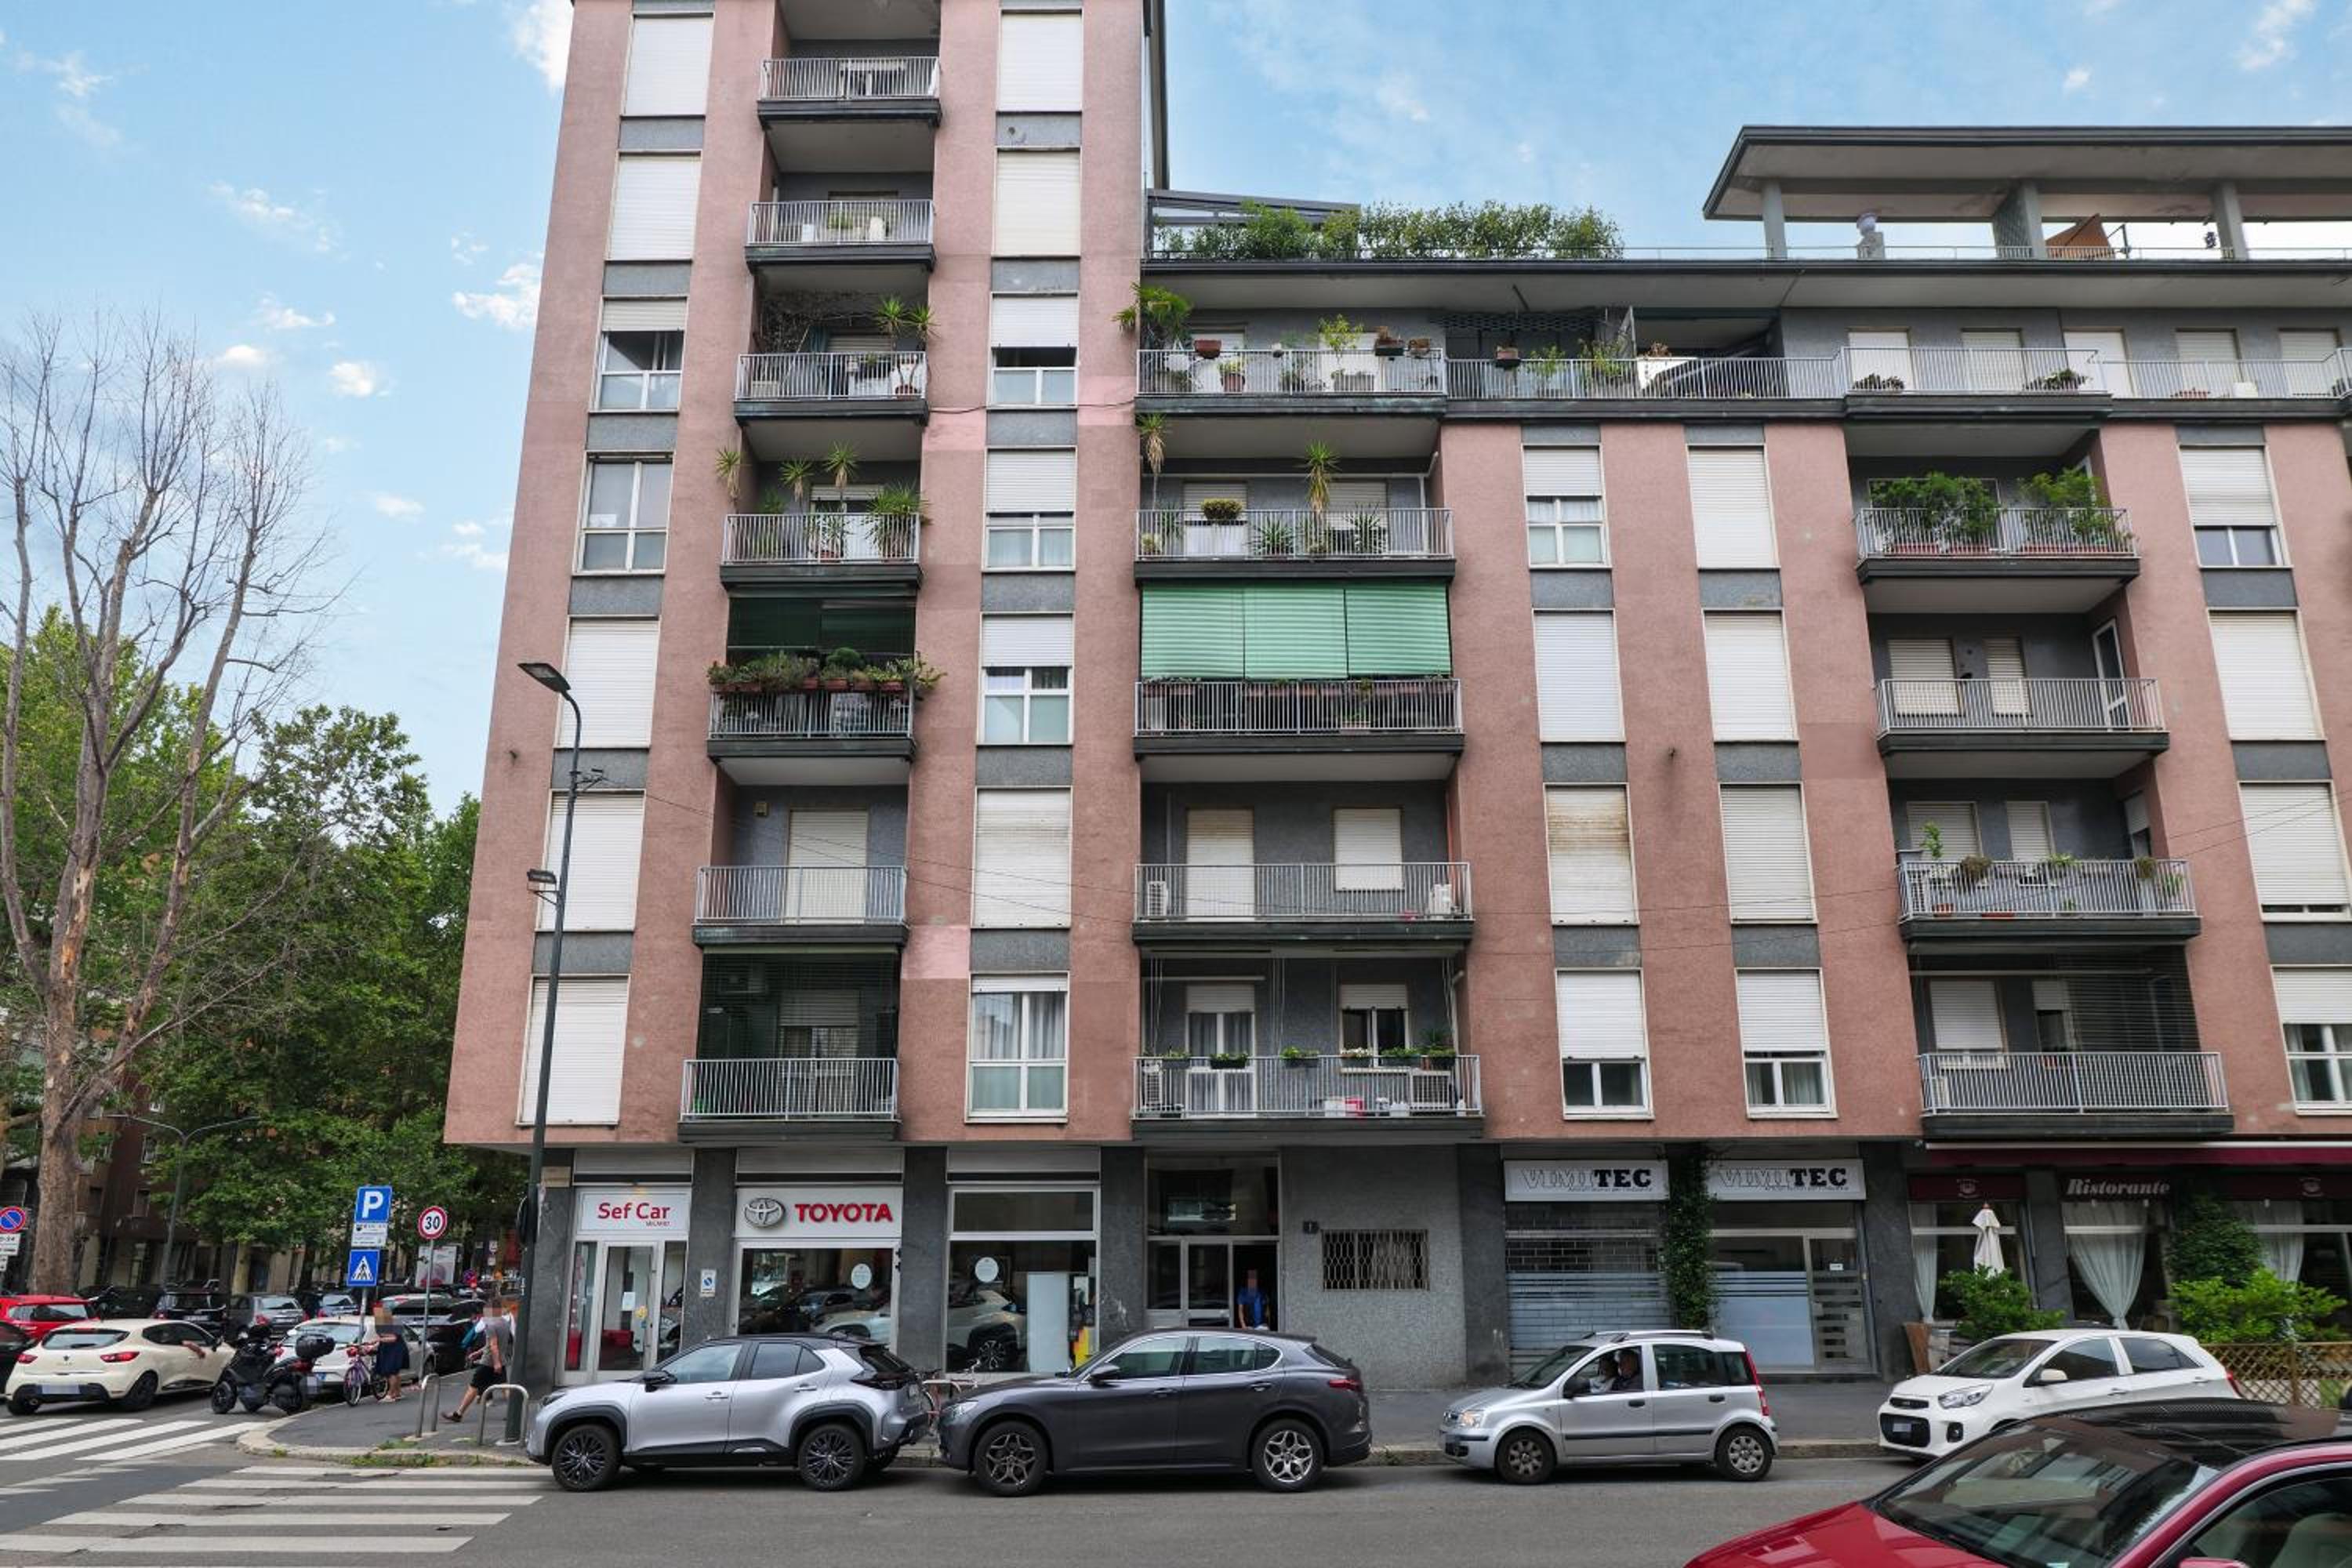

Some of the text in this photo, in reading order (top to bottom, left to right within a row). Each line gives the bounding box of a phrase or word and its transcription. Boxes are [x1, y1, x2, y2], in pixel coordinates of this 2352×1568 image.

[2067, 1178, 2170, 1195] Ristorante
[362, 1191, 383, 1218] P
[597, 1202, 670, 1219] Sef Car
[795, 1203, 893, 1222] TOYOTA
[424, 1216, 441, 1230] 30
